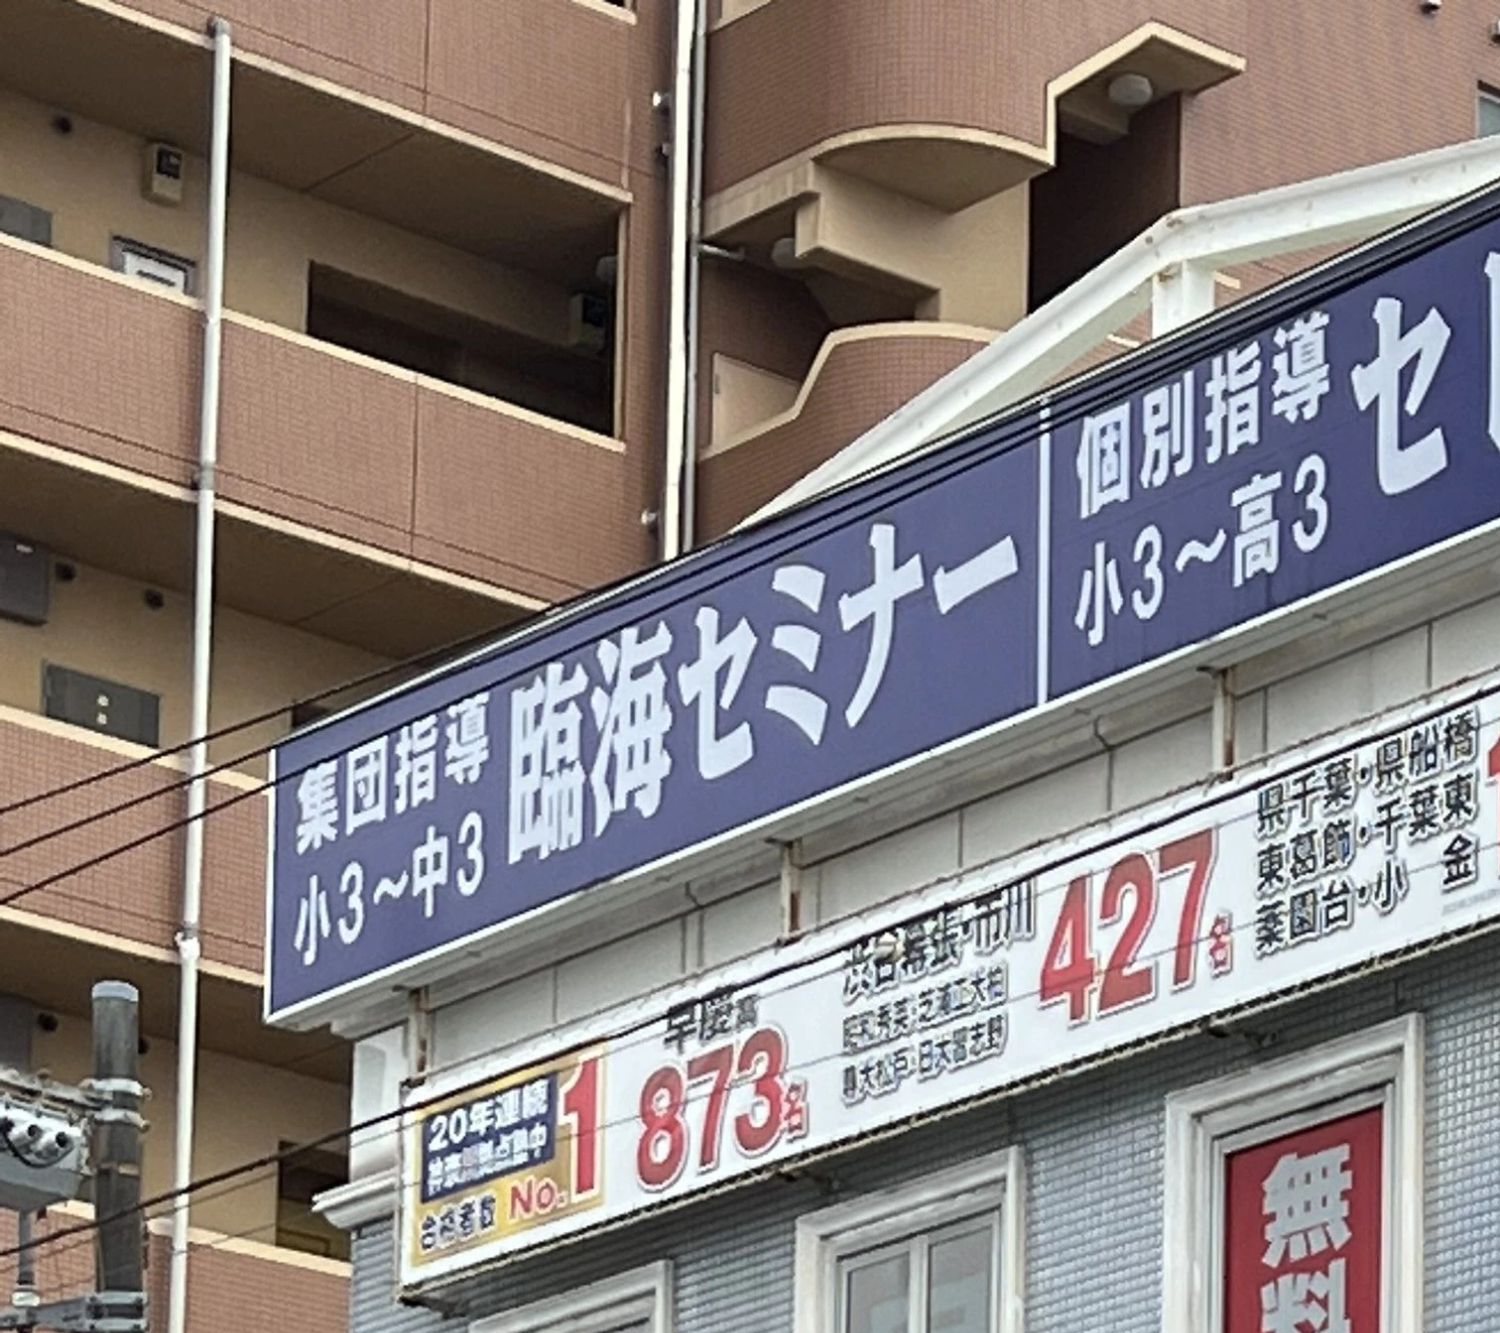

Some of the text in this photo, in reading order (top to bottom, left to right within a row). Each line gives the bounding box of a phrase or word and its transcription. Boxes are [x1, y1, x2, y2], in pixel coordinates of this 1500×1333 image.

[1075, 311, 1331, 520] 個別指導
[295, 692, 490, 856] 集団指導
[507, 522, 1019, 866] 臨海セミナー
